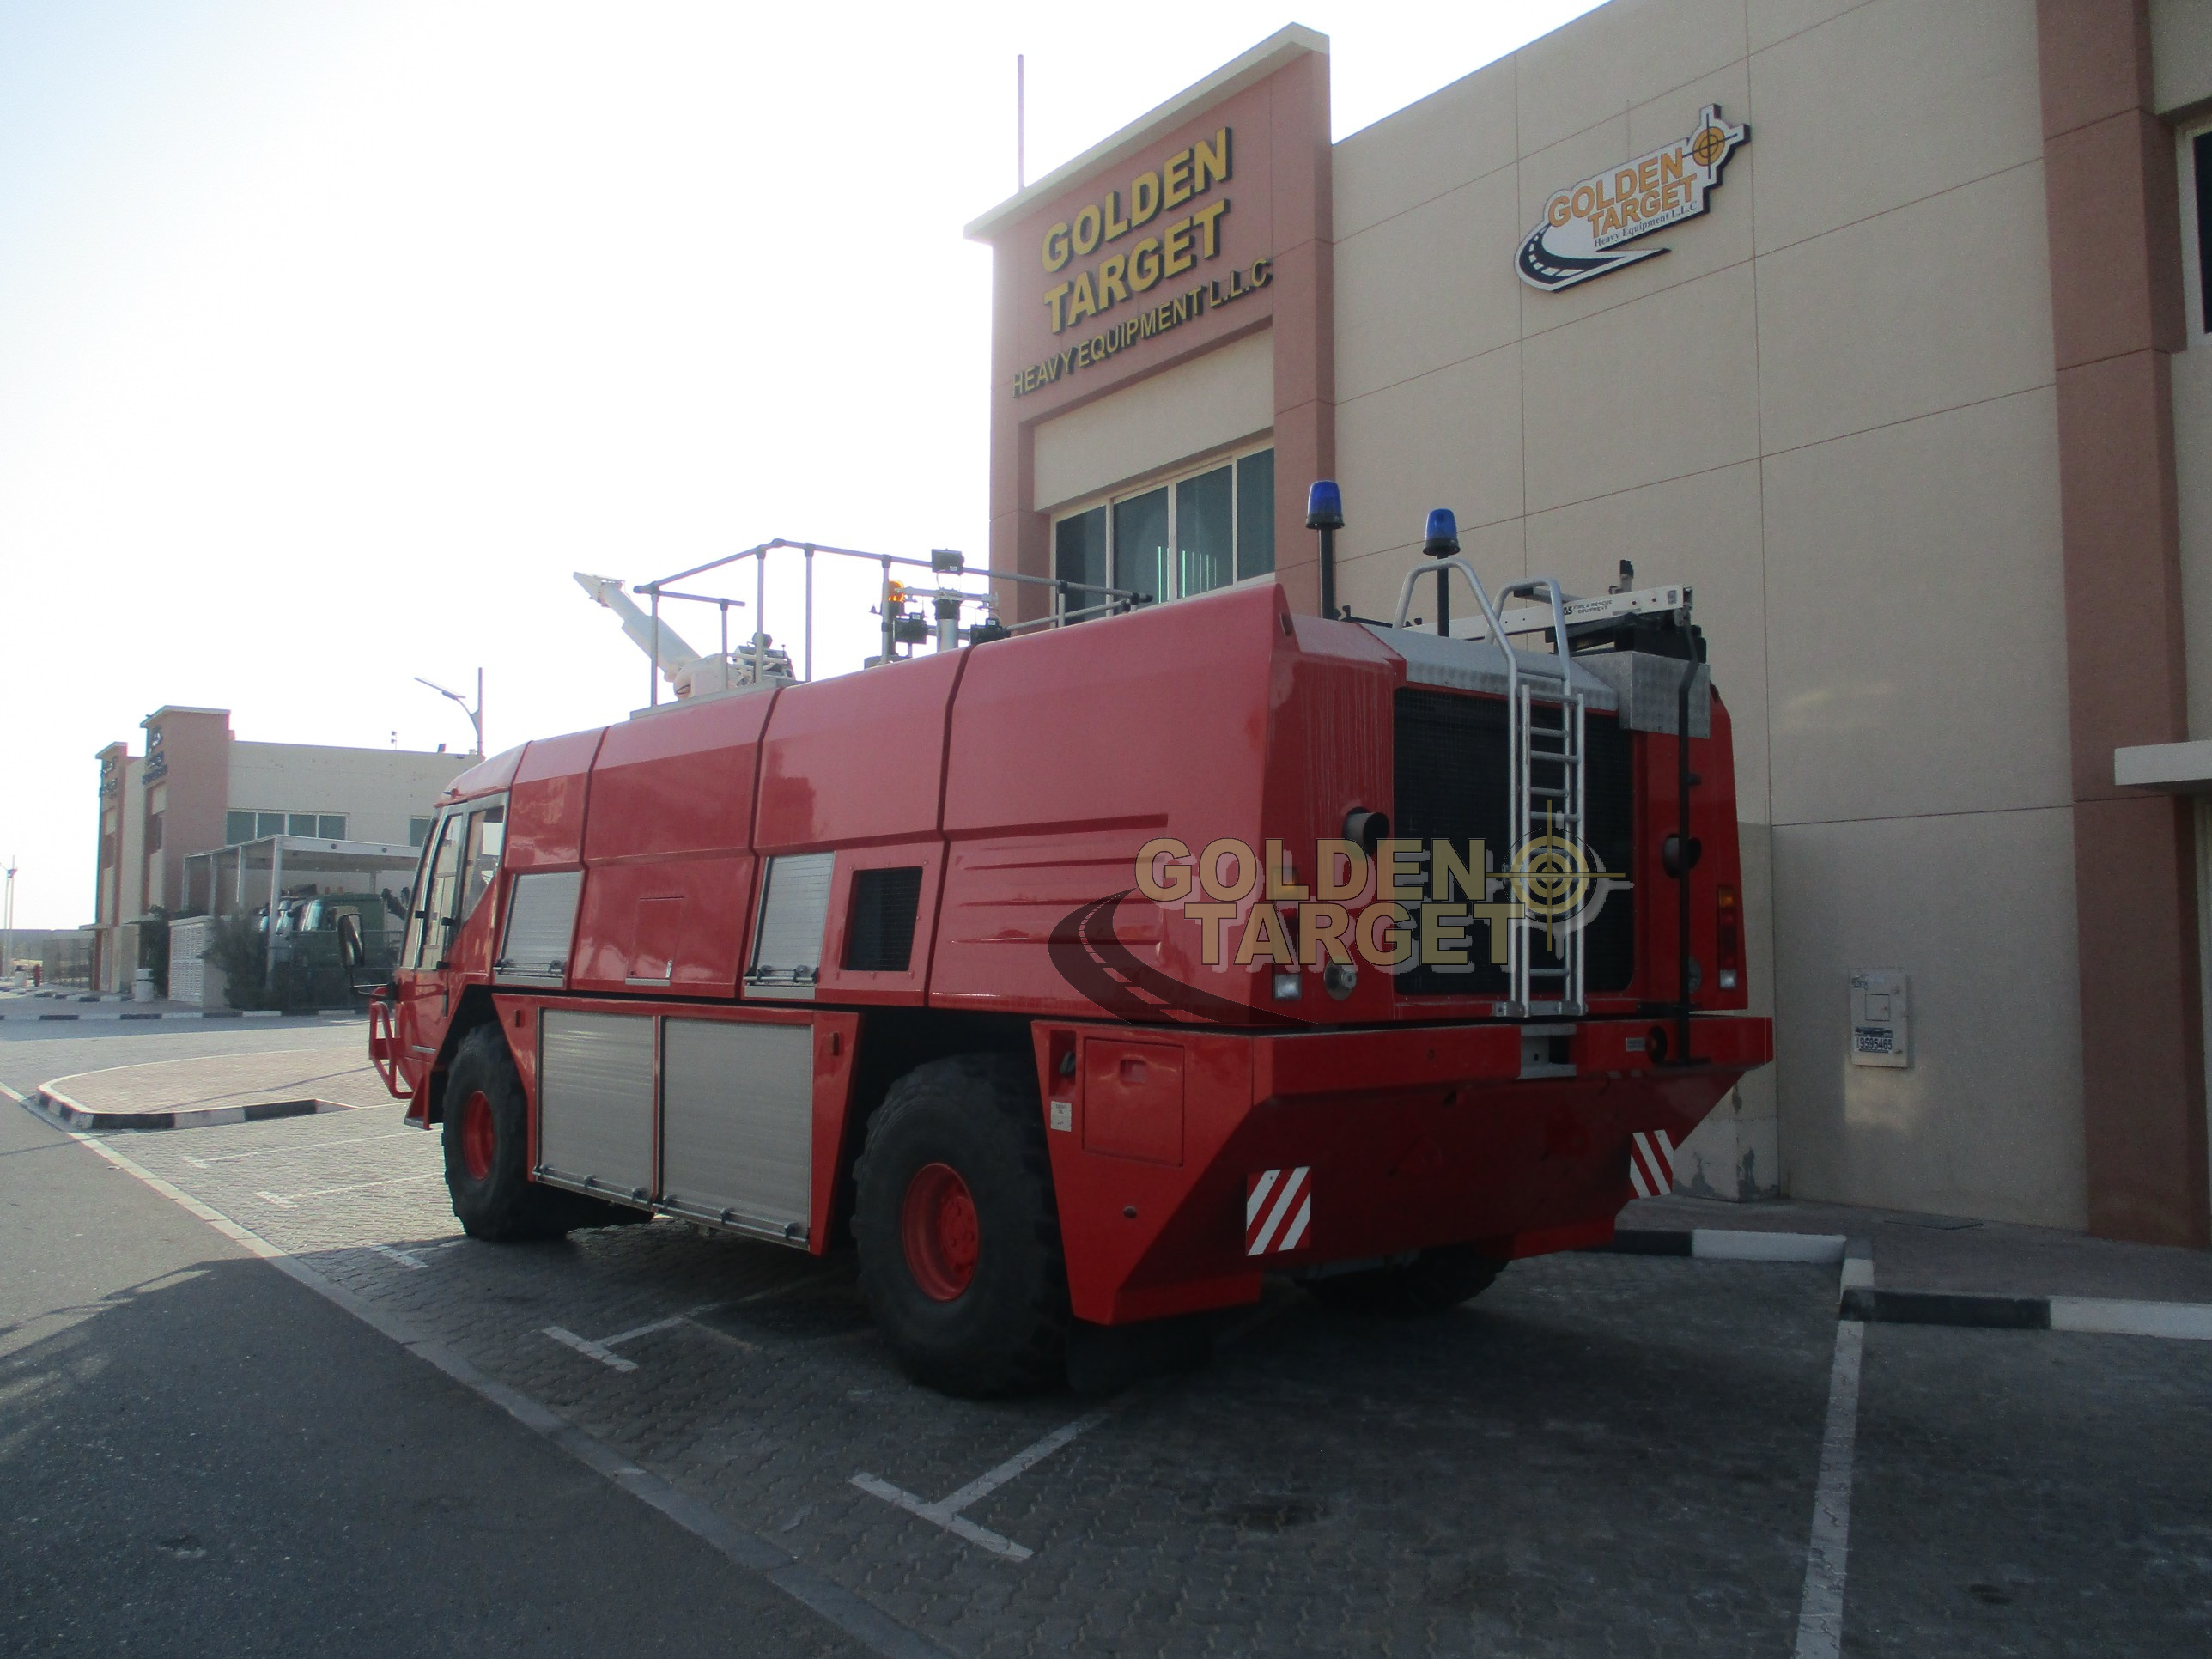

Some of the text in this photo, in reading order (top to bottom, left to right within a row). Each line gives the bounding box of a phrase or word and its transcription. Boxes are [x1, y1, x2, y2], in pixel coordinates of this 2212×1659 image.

[1042, 127, 1231, 273] GOLDEN
[1548, 147, 1683, 228] GOLDEN
[1588, 173, 1697, 239] TARGET
[1595, 232, 1619, 247] Heavy
[1622, 214, 1669, 237] Equipment
[1044, 198, 1230, 335] TARGET
[1012, 346, 1078, 398] HEAVY
[1079, 285, 1205, 369] EQUIPMENT
